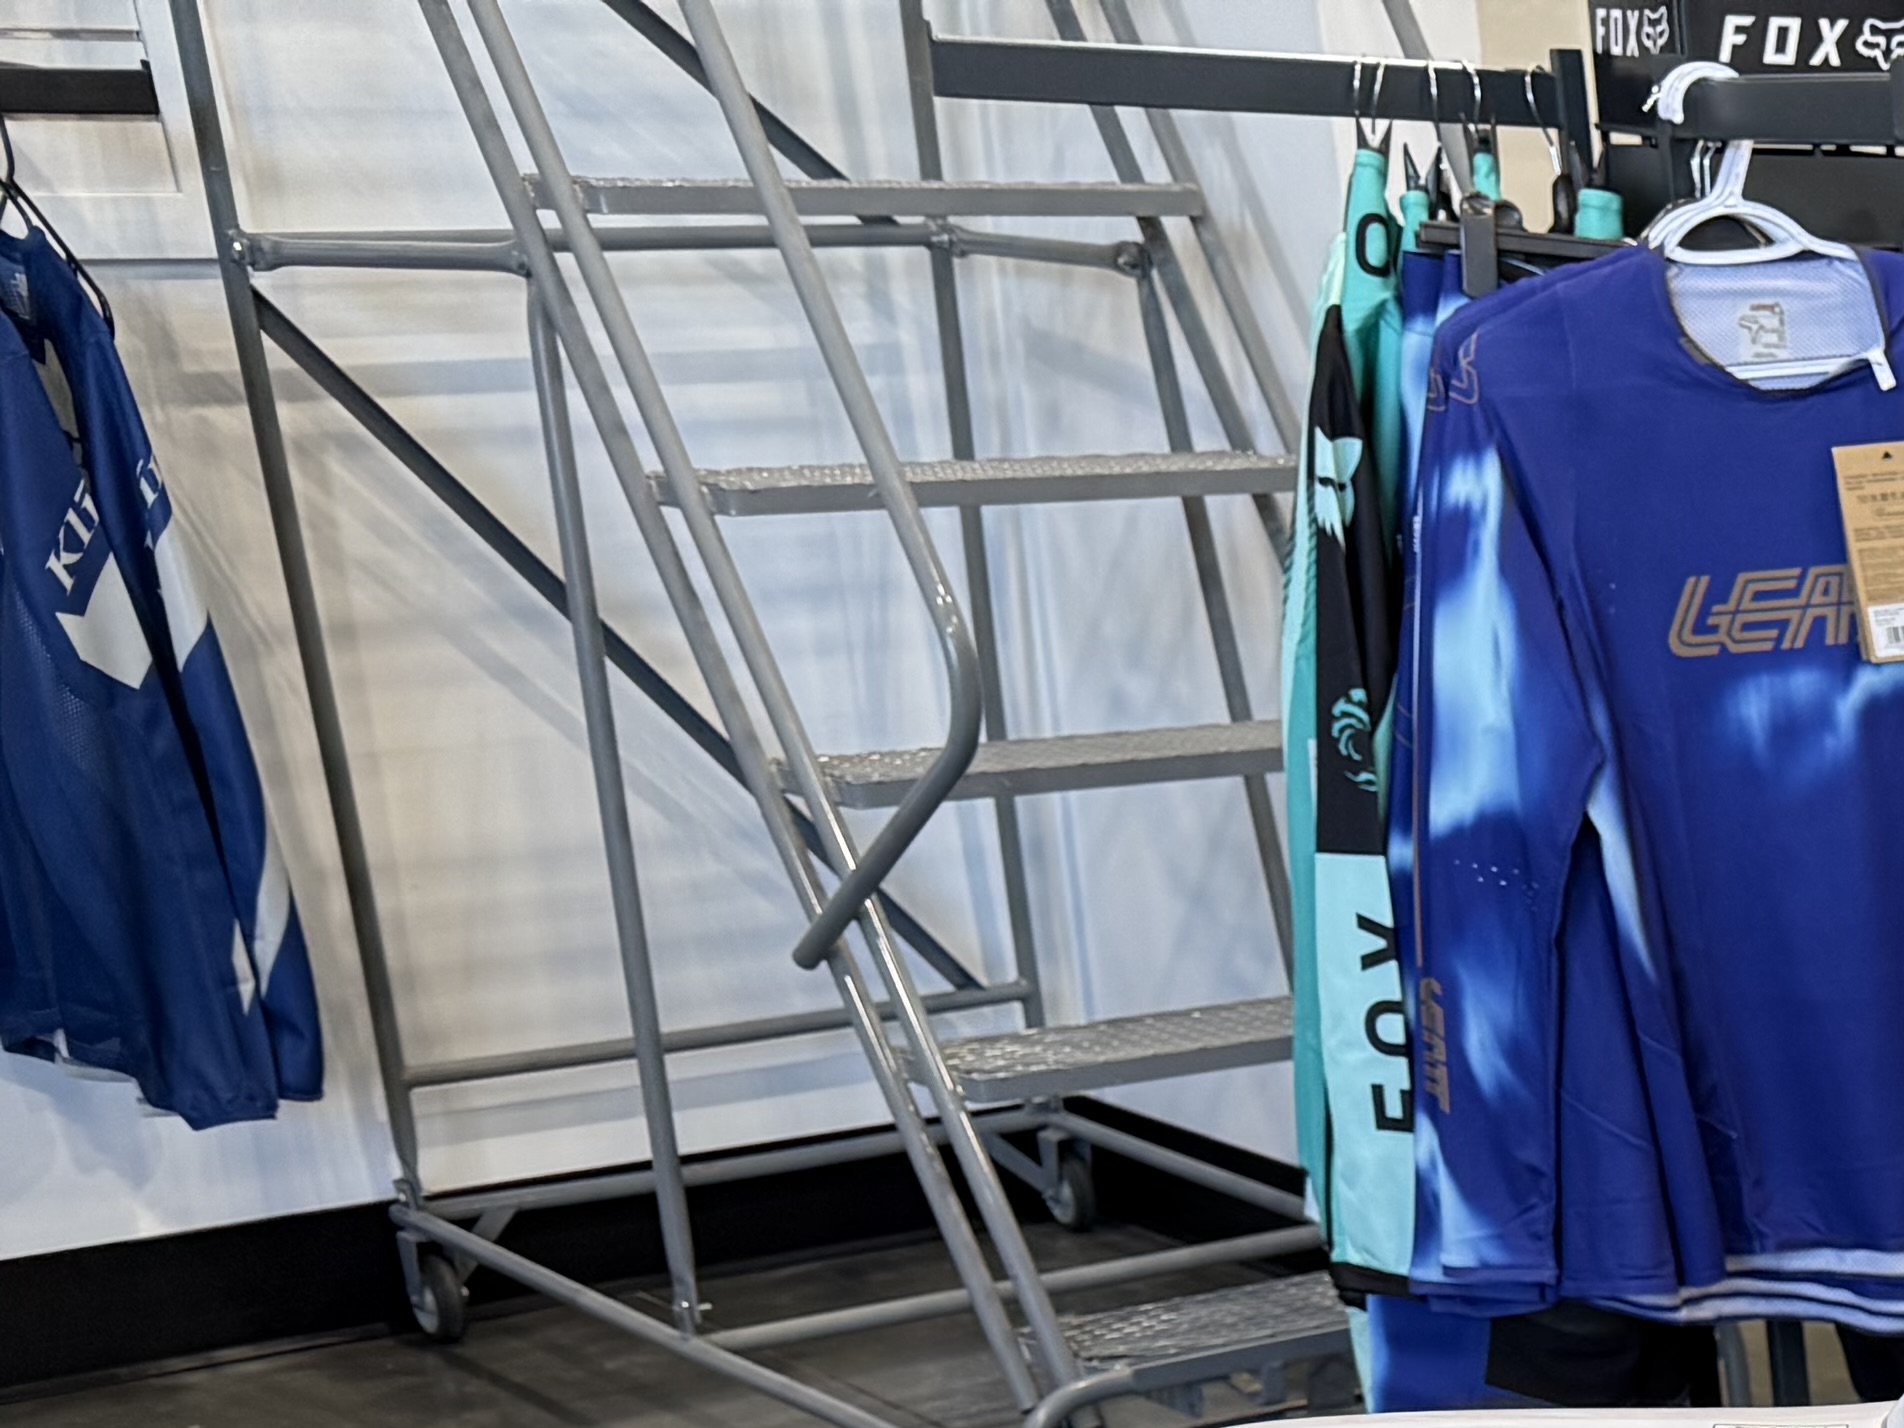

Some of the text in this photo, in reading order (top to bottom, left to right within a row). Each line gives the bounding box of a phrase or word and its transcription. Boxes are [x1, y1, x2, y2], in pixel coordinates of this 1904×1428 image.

[1595, 8, 1640, 58] FOX
[1718, 14, 1850, 68] FOX
[1667, 563, 1856, 658] LEA
